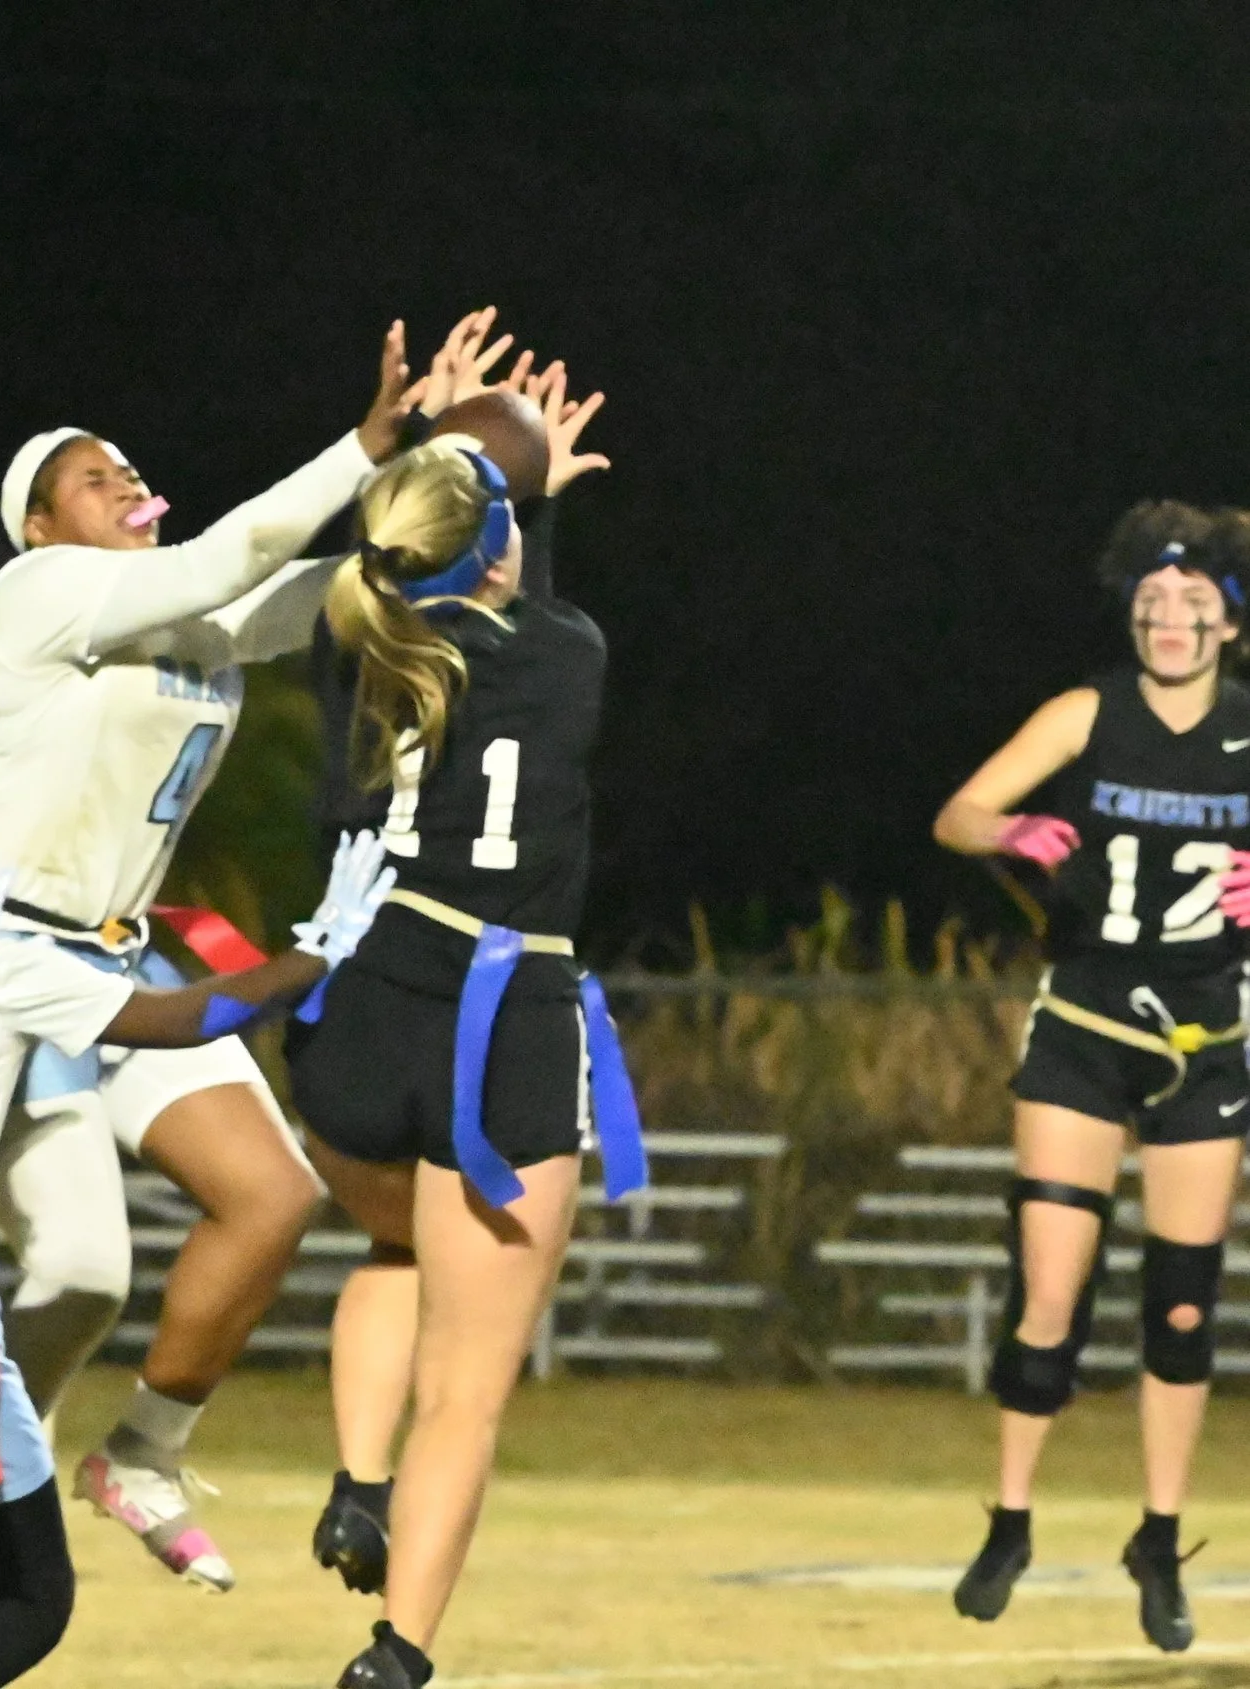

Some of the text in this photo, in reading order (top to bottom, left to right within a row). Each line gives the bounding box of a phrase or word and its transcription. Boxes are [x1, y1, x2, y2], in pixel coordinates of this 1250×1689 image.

[147, 722, 224, 834] 4
[379, 728, 520, 870] 11
[1101, 834, 1234, 944] 12
